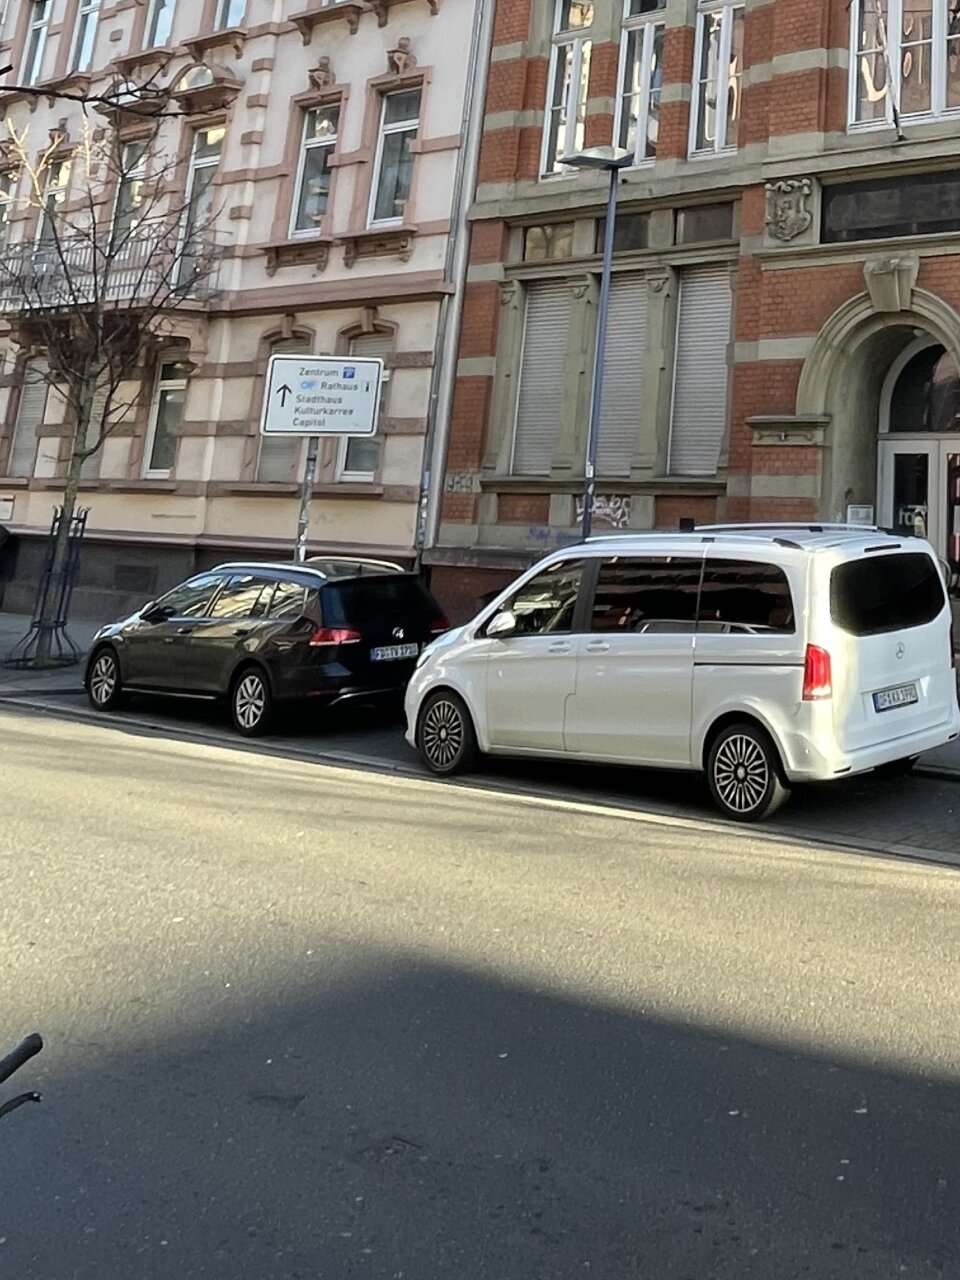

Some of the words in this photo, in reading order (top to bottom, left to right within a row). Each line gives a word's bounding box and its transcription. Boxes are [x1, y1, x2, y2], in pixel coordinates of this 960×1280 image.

[298, 367, 339, 376] Zentrum
[320, 381, 359, 391] Rathaus
[295, 394, 343, 404] Stadthaus
[293, 406, 354, 416] Kulturkarree
[292, 418, 326, 427] Capitol
